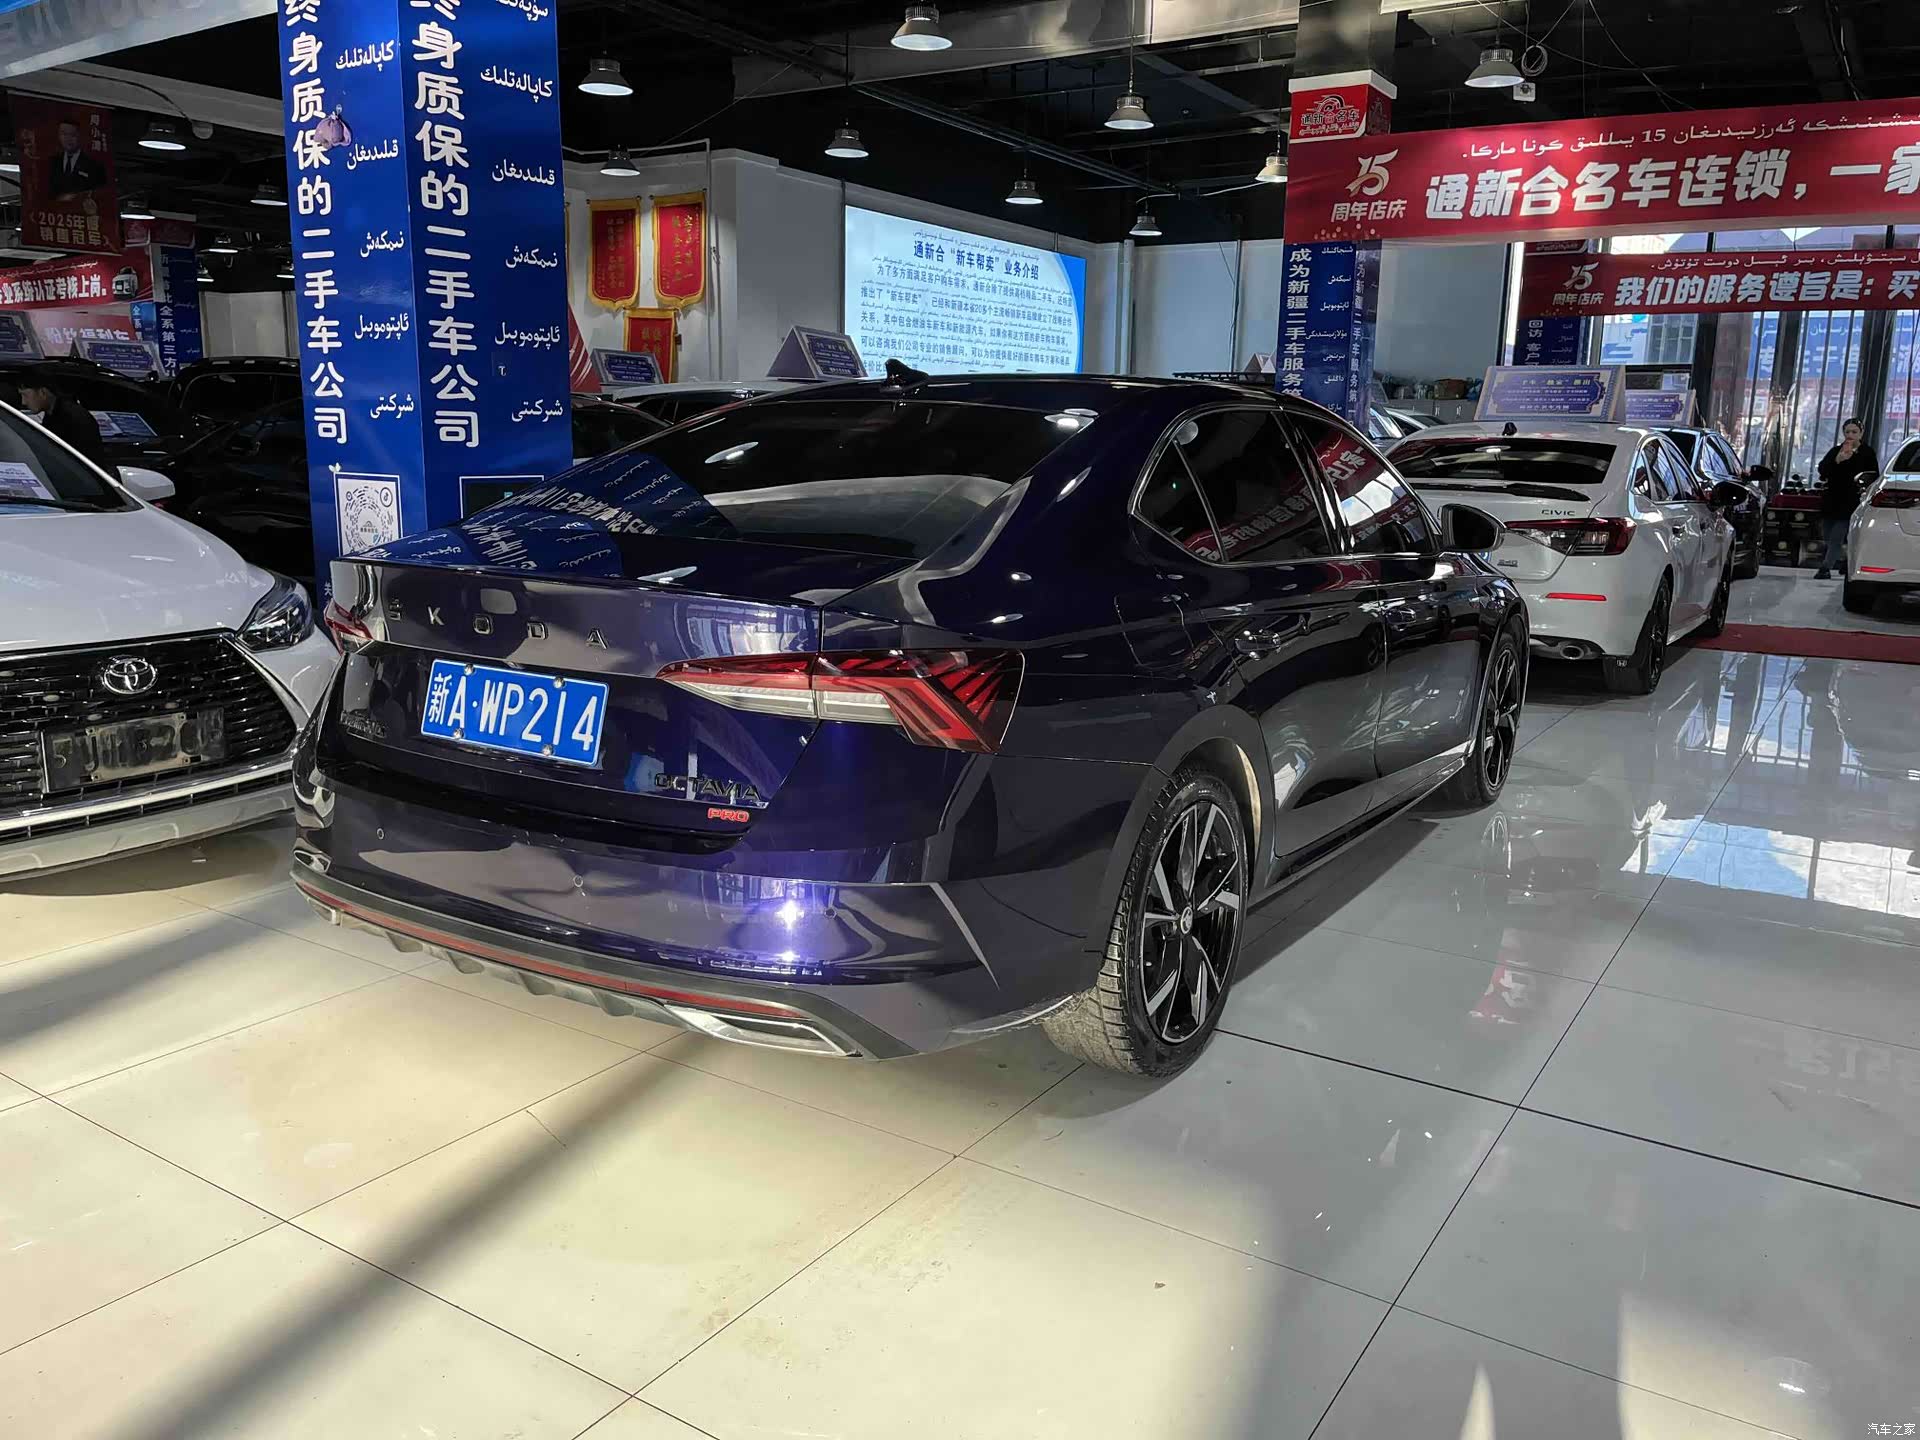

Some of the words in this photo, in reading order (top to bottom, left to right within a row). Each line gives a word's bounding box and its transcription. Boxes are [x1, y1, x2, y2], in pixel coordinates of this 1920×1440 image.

[1642, 129, 1666, 143] 15
[1521, 139, 1563, 156] كونا
[1331, 199, 1408, 222] 周年店庆
[1552, 292, 1605, 306] 周年店庆
[1541, 509, 1576, 517] CIVIC
[655, 773, 762, 801] OCTAVIA
[706, 807, 750, 823] PRO
